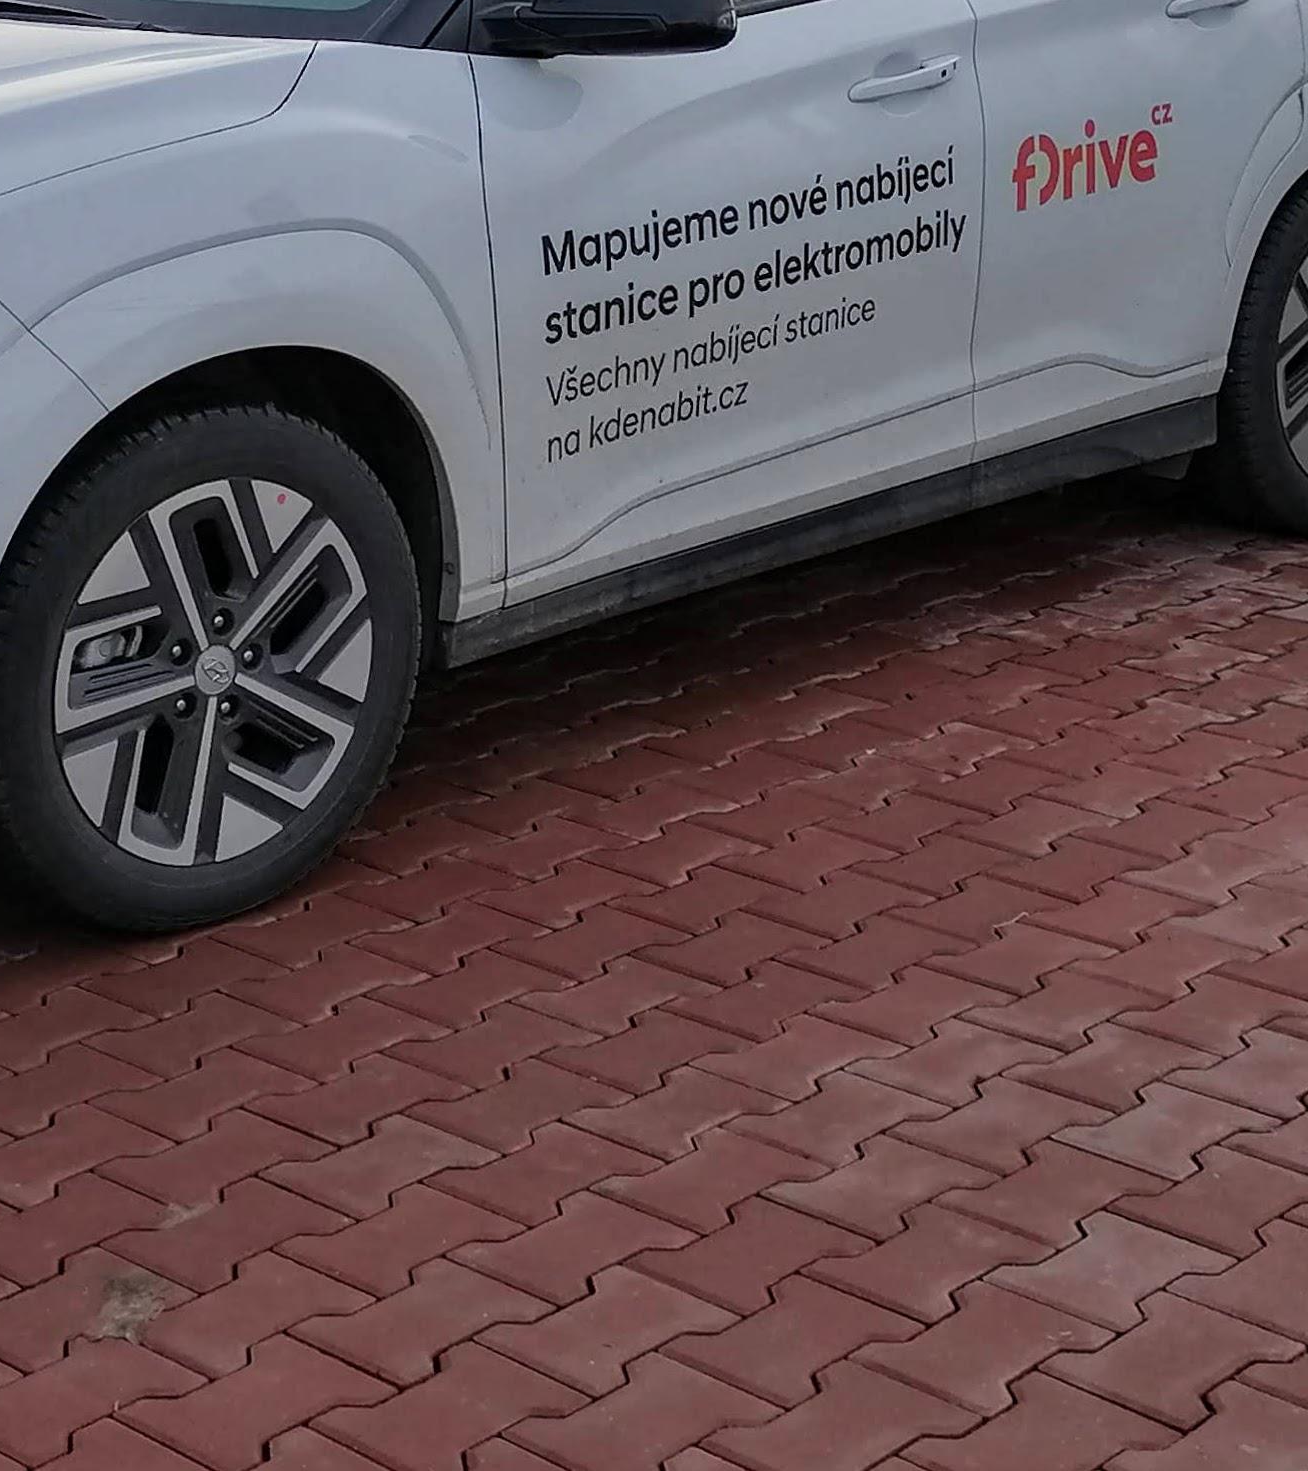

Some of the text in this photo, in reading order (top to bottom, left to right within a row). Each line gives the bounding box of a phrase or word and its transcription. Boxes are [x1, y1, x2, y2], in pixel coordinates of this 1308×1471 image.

[541, 145, 954, 276] Mapujeme nové nabíjecí
[545, 208, 967, 345] stanice pro elektromobily
[546, 297, 876, 407] Všechny nabíjecí stanice
[547, 380, 749, 464] na kdenabit.cz
